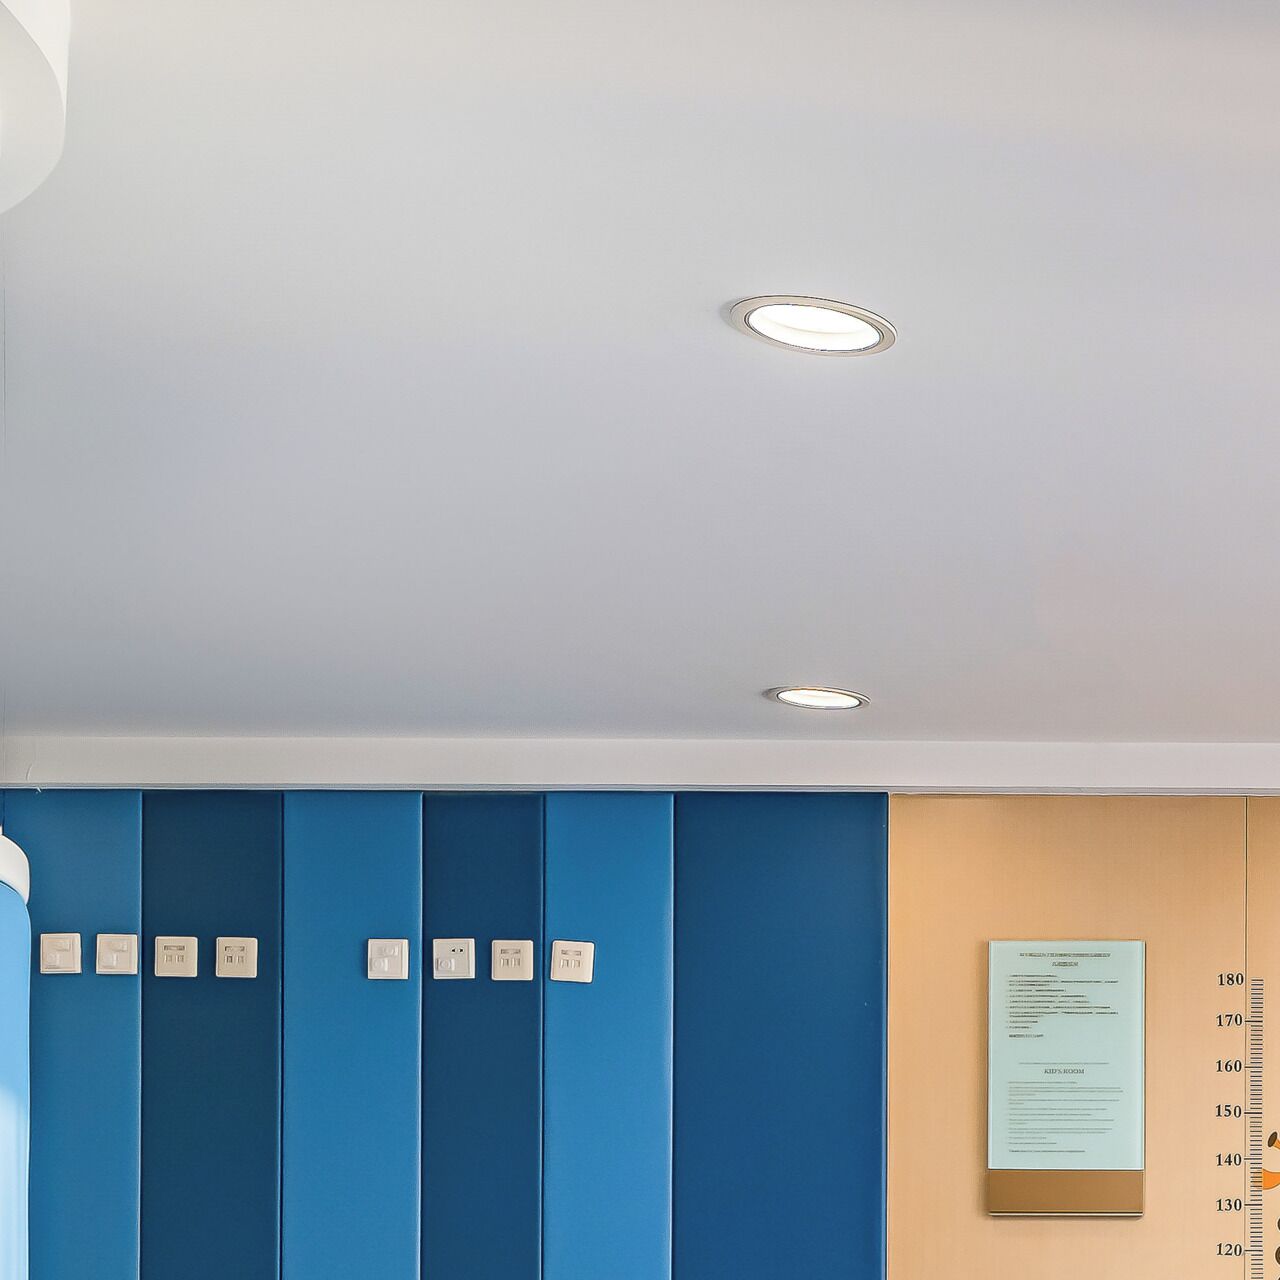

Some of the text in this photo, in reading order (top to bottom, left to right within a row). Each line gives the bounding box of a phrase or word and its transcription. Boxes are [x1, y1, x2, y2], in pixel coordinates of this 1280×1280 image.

[1217, 972, 1244, 986] 180
[1216, 1013, 1243, 1027] 170
[1216, 1059, 1242, 1073] 160
[1215, 1104, 1242, 1118] 150
[1215, 1153, 1242, 1167] 140
[1216, 1198, 1242, 1212] 130
[1216, 1243, 1242, 1257] 120
